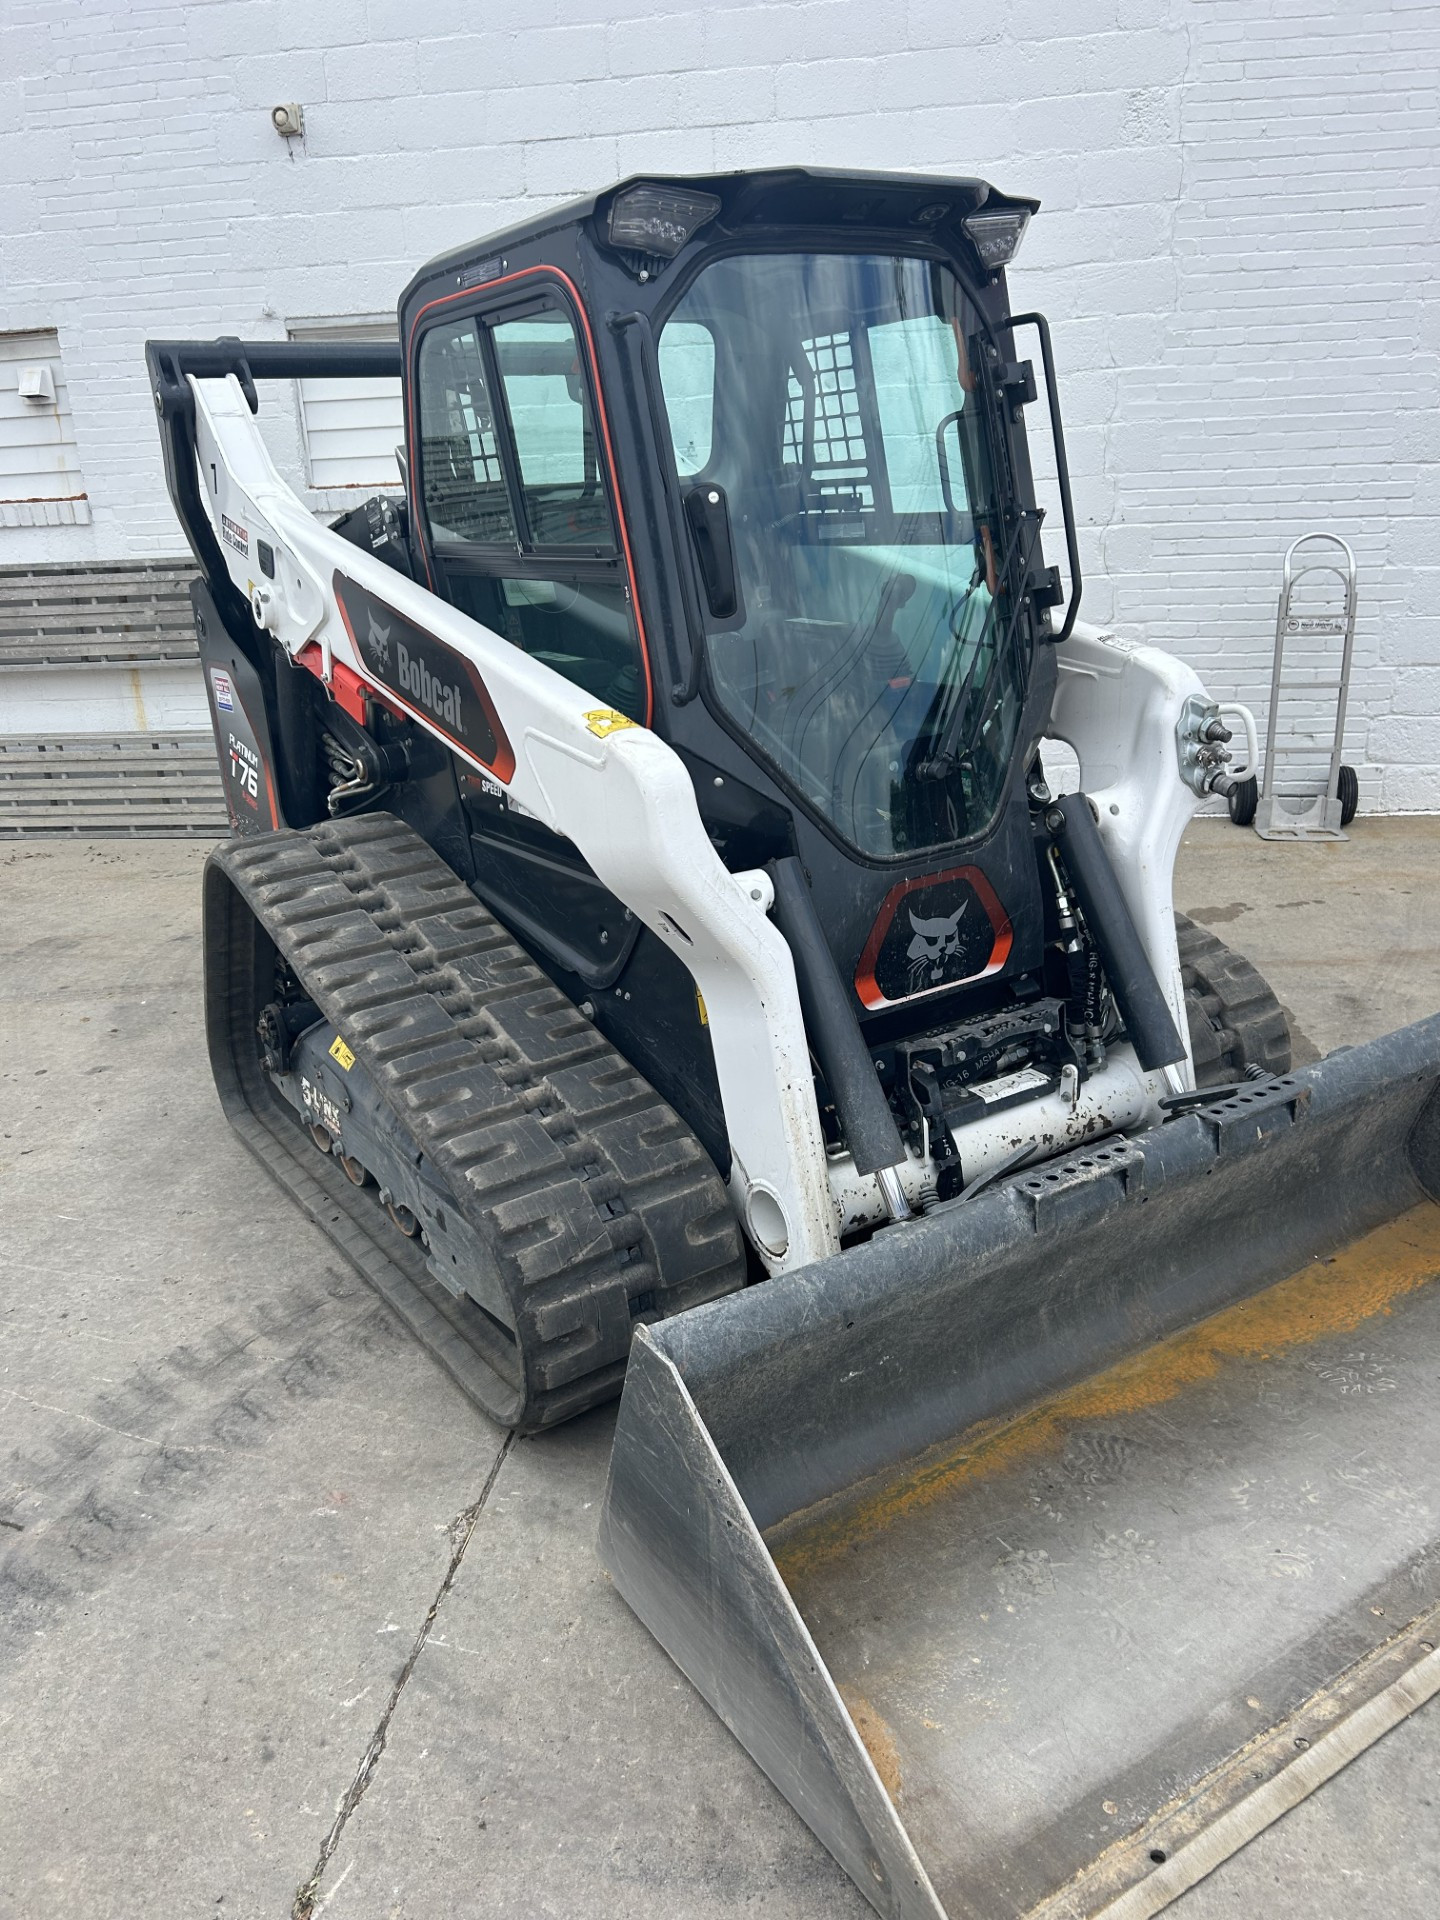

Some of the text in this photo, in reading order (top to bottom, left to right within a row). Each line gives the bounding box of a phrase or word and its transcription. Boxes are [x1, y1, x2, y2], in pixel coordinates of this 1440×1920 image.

[397, 641, 463, 732] Bobcat
[229, 733, 258, 768] PLATINUM
[229, 748, 258, 798] T76
[481, 779, 502, 797] SPEED
[975, 1049, 1000, 1071] MSHA
